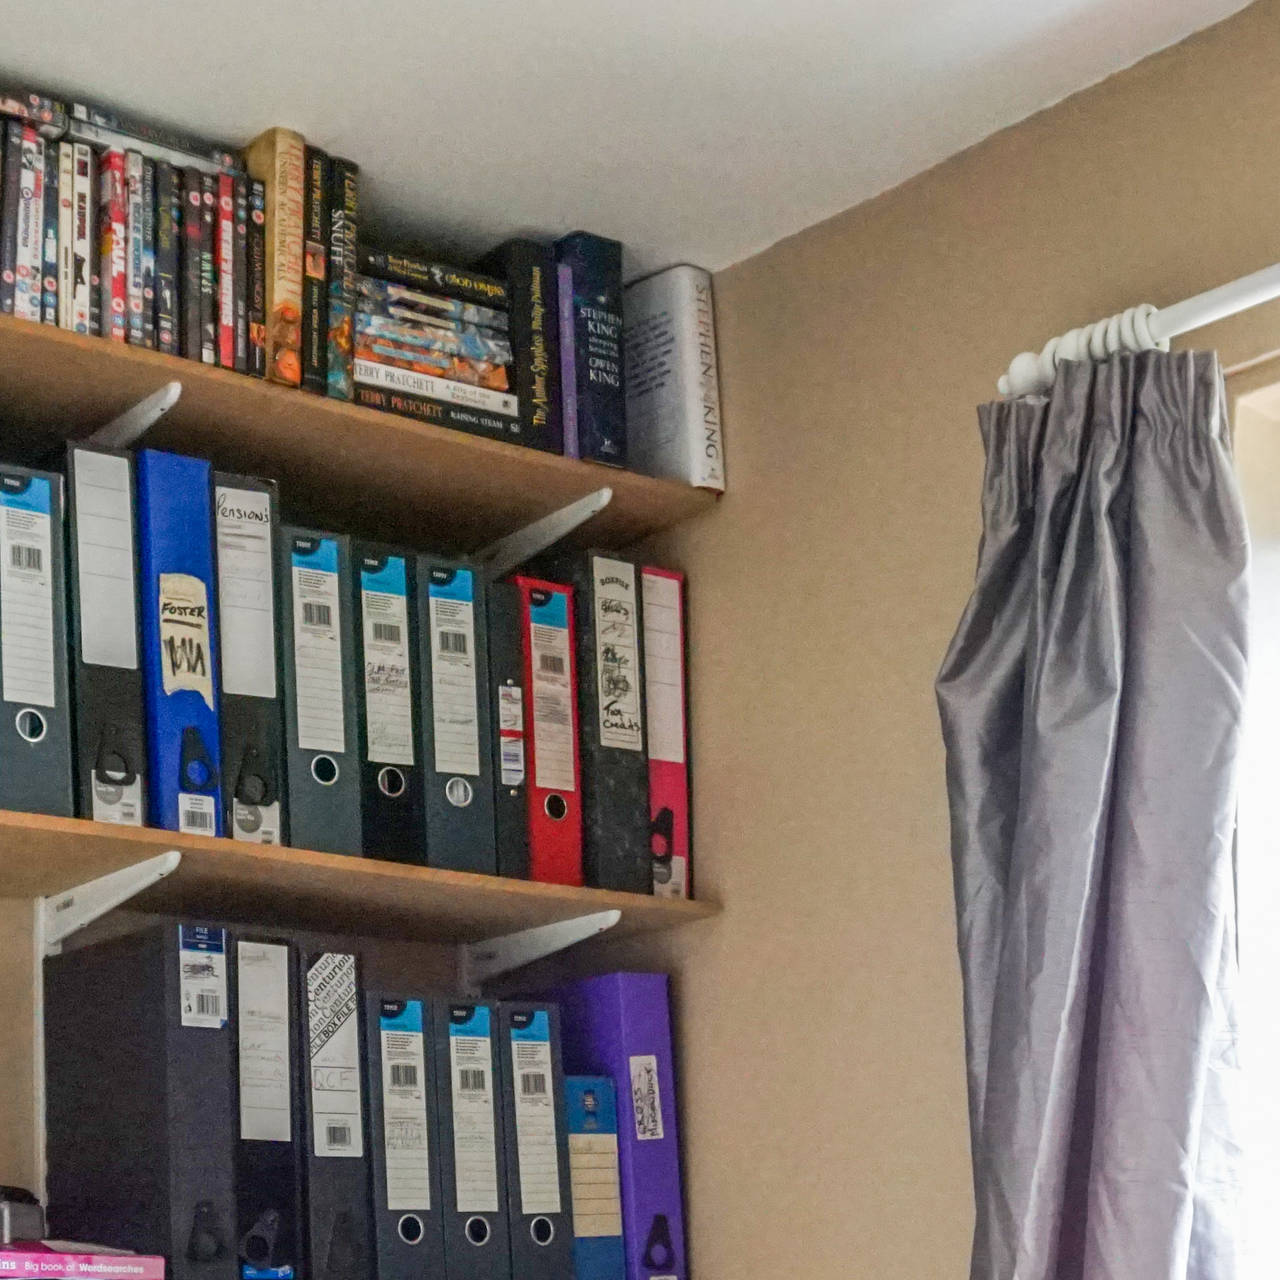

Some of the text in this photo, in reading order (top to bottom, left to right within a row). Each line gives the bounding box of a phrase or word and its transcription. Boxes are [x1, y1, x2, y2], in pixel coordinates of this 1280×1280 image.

[330, 208, 345, 267] SNUFF
[111, 221, 125, 277] PAUL
[580, 307, 622, 324] STEPHEN
[587, 320, 618, 339] KING
[588, 357, 619, 373] OWEN
[695, 284, 719, 460] STEPHEN KING
[384, 369, 435, 393] PRATCHETT
[589, 369, 620, 387] KING
[391, 397, 443, 418] PRATCHETT
[161, 602, 206, 619] FOSTER
[195, 925, 209, 935] FILE
[322, 1020, 339, 1039] BOX
[335, 1002, 353, 1023] FILE
[24, 1262, 39, 1273] Big
[40, 1262, 63, 1272] book
[78, 1263, 145, 1274] Wordsearches
